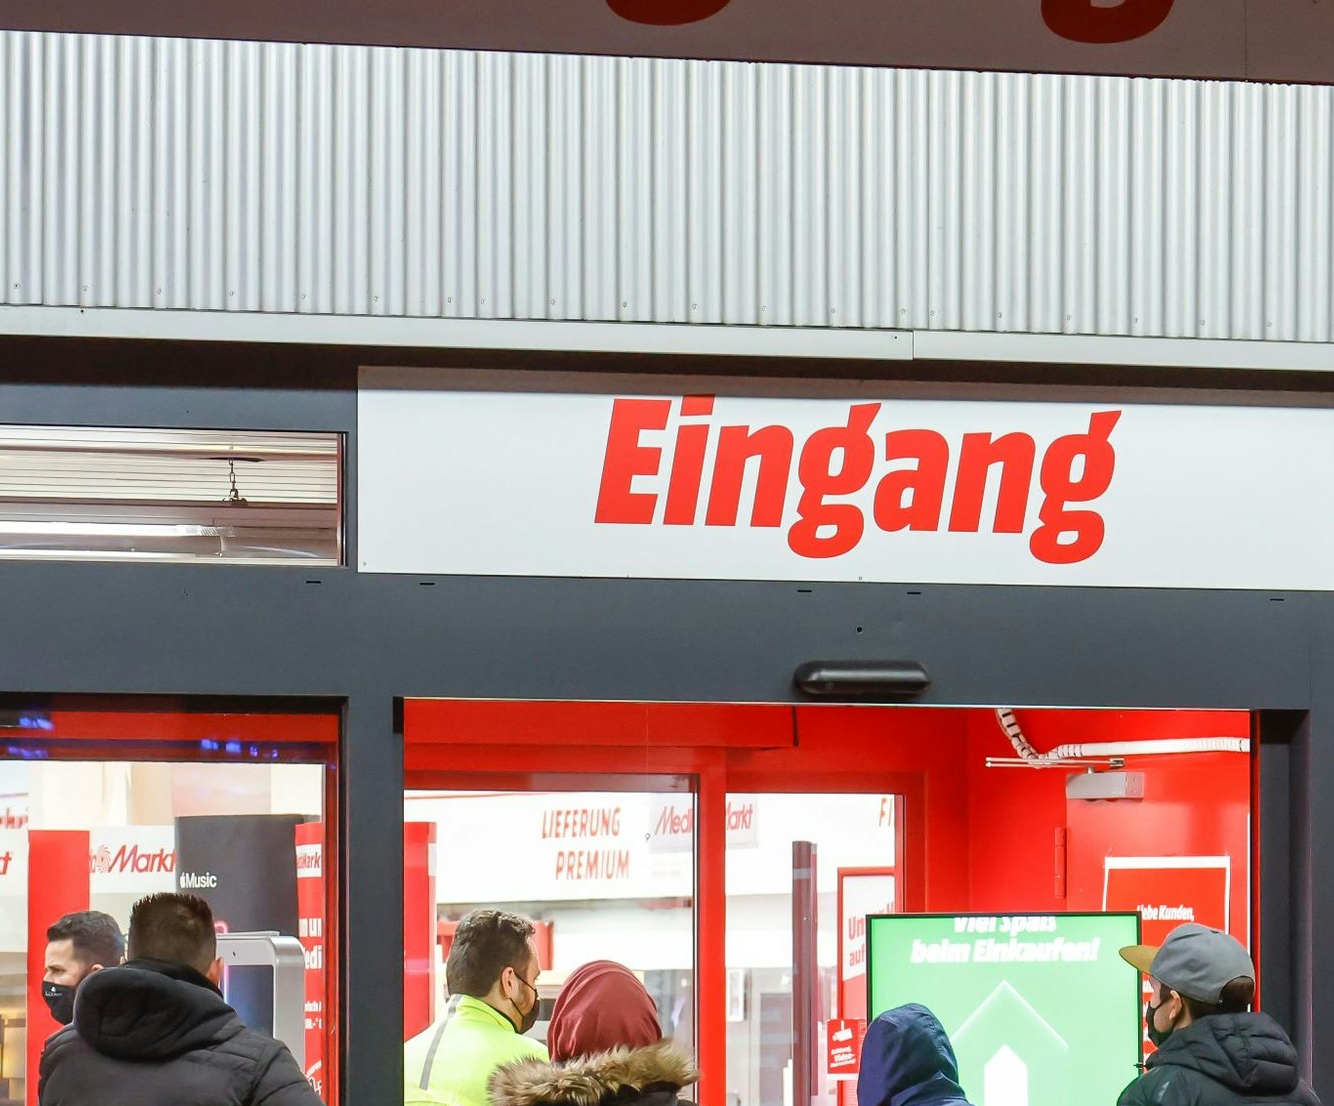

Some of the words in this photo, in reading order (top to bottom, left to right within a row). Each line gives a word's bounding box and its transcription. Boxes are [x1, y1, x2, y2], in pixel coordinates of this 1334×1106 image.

[593, 393, 1123, 564] Eingang
[541, 807, 621, 839] LIEFERUNG
[725, 802, 754, 831] arkt
[555, 849, 630, 880] PREMIUM
[185, 871, 217, 888] Music
[1157, 905, 1195, 922] Kunden,
[910, 938, 971, 964] beim
[972, 937, 1101, 964] Einkaufen!
